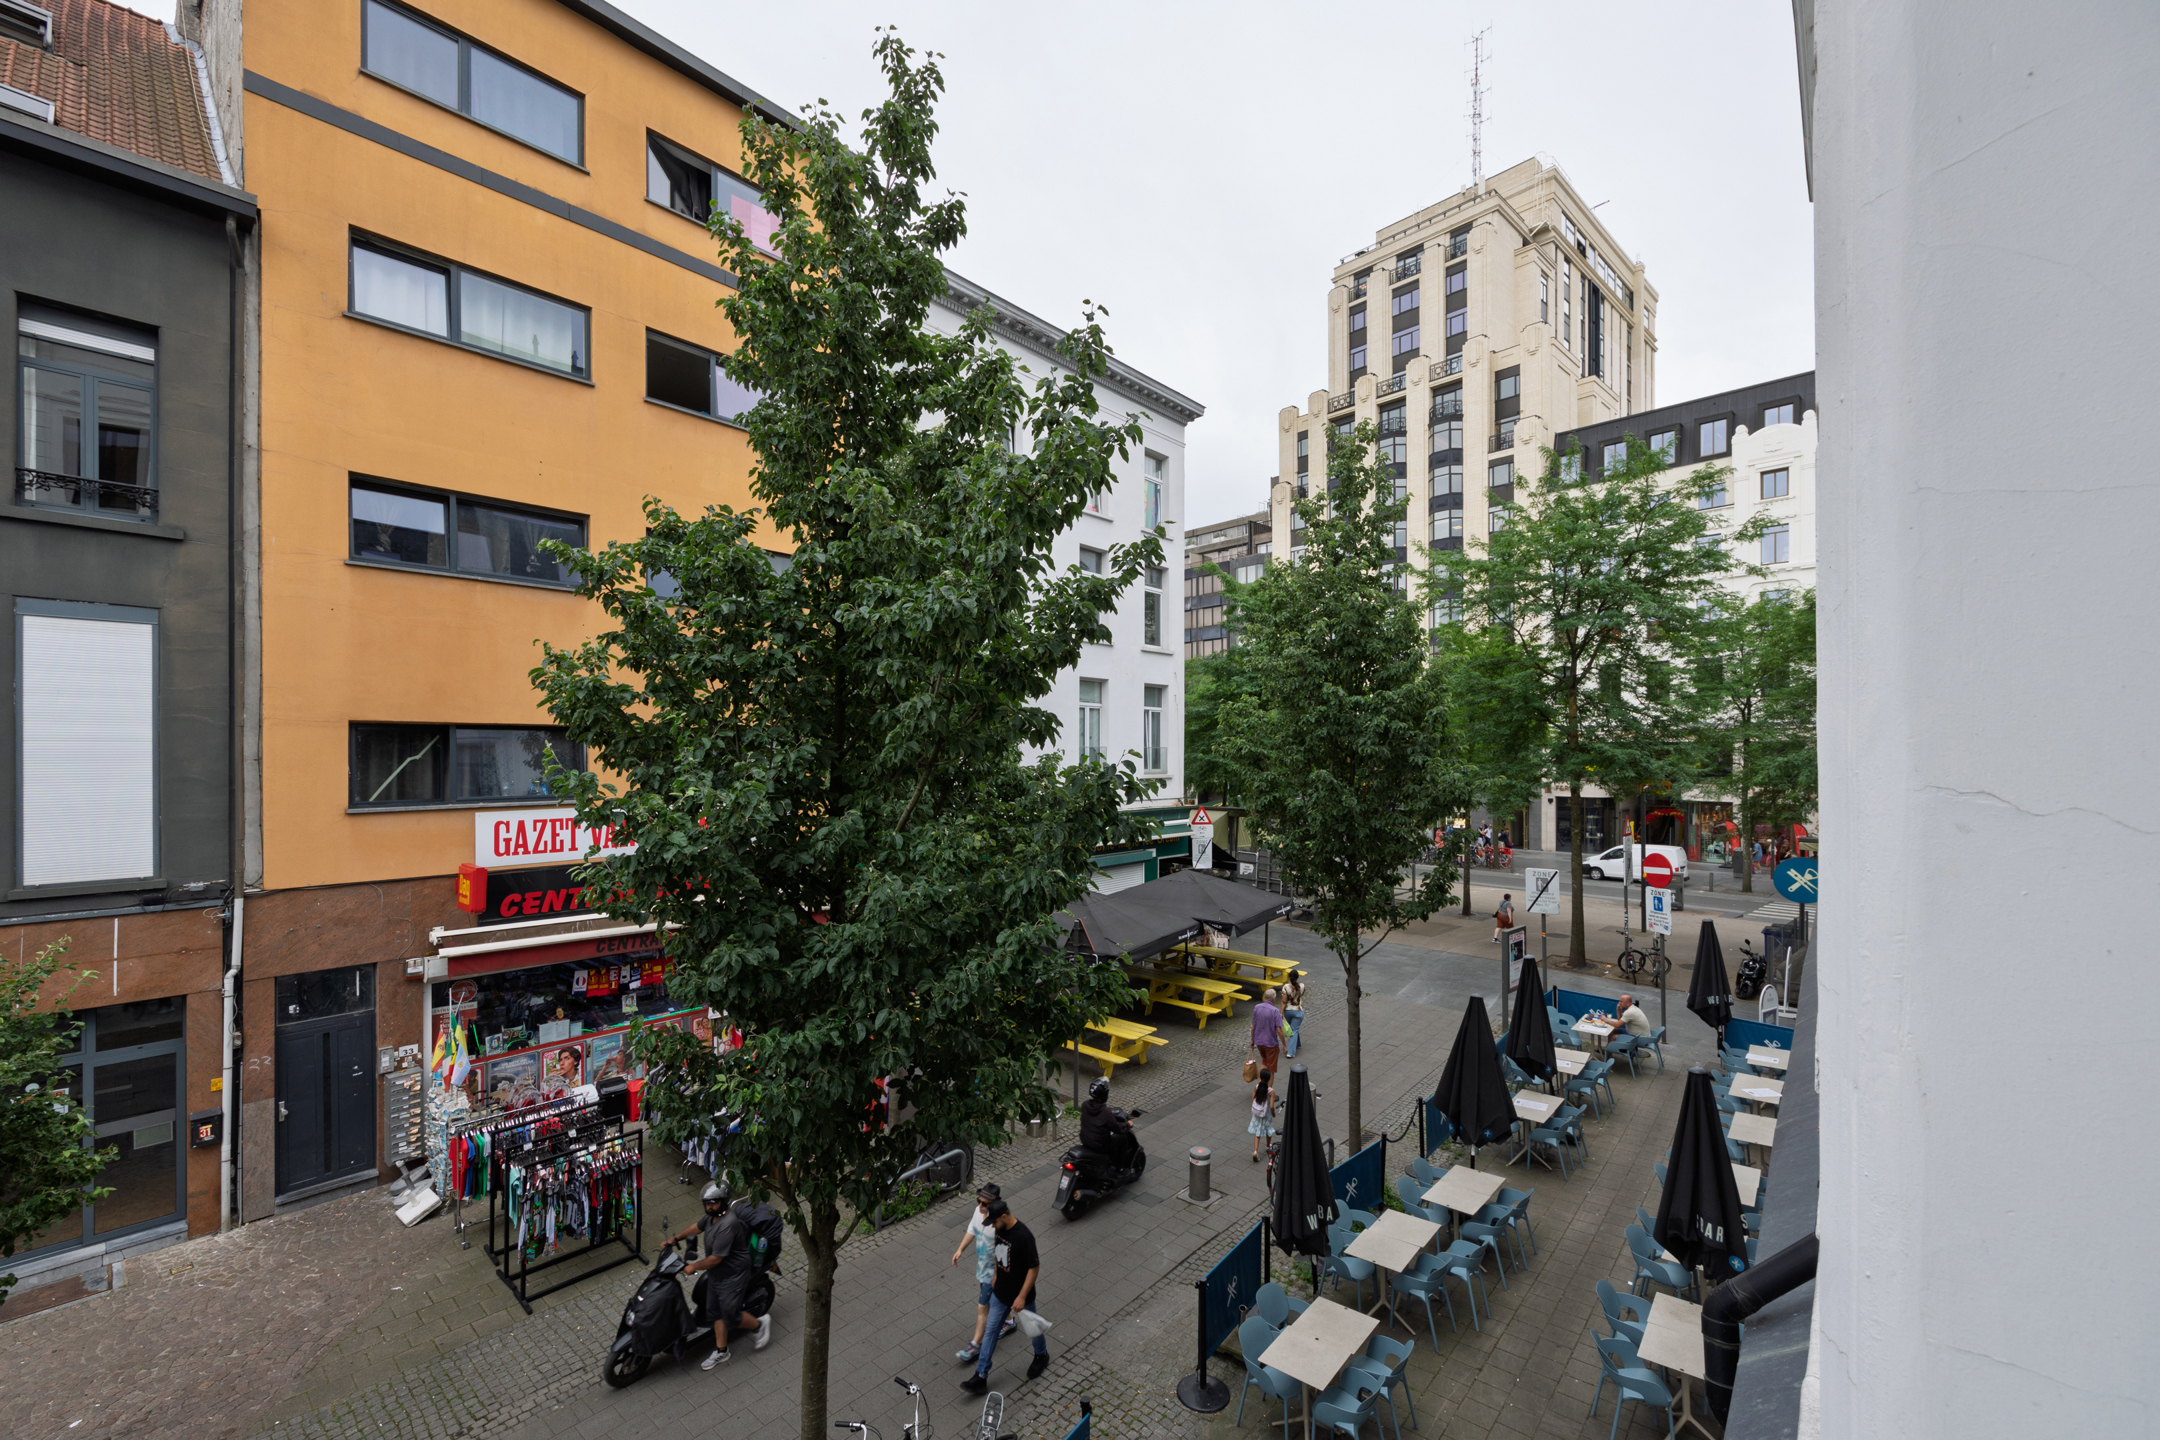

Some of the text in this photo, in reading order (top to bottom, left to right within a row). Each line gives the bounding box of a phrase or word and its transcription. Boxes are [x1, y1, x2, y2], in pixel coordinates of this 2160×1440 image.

[493, 818, 582, 857] GAZET
[1650, 889, 1666, 897] ZONE
[596, 932, 665, 953] CENTRA
[402, 1048, 414, 1056] 33
[200, 1127, 211, 1138] 31
